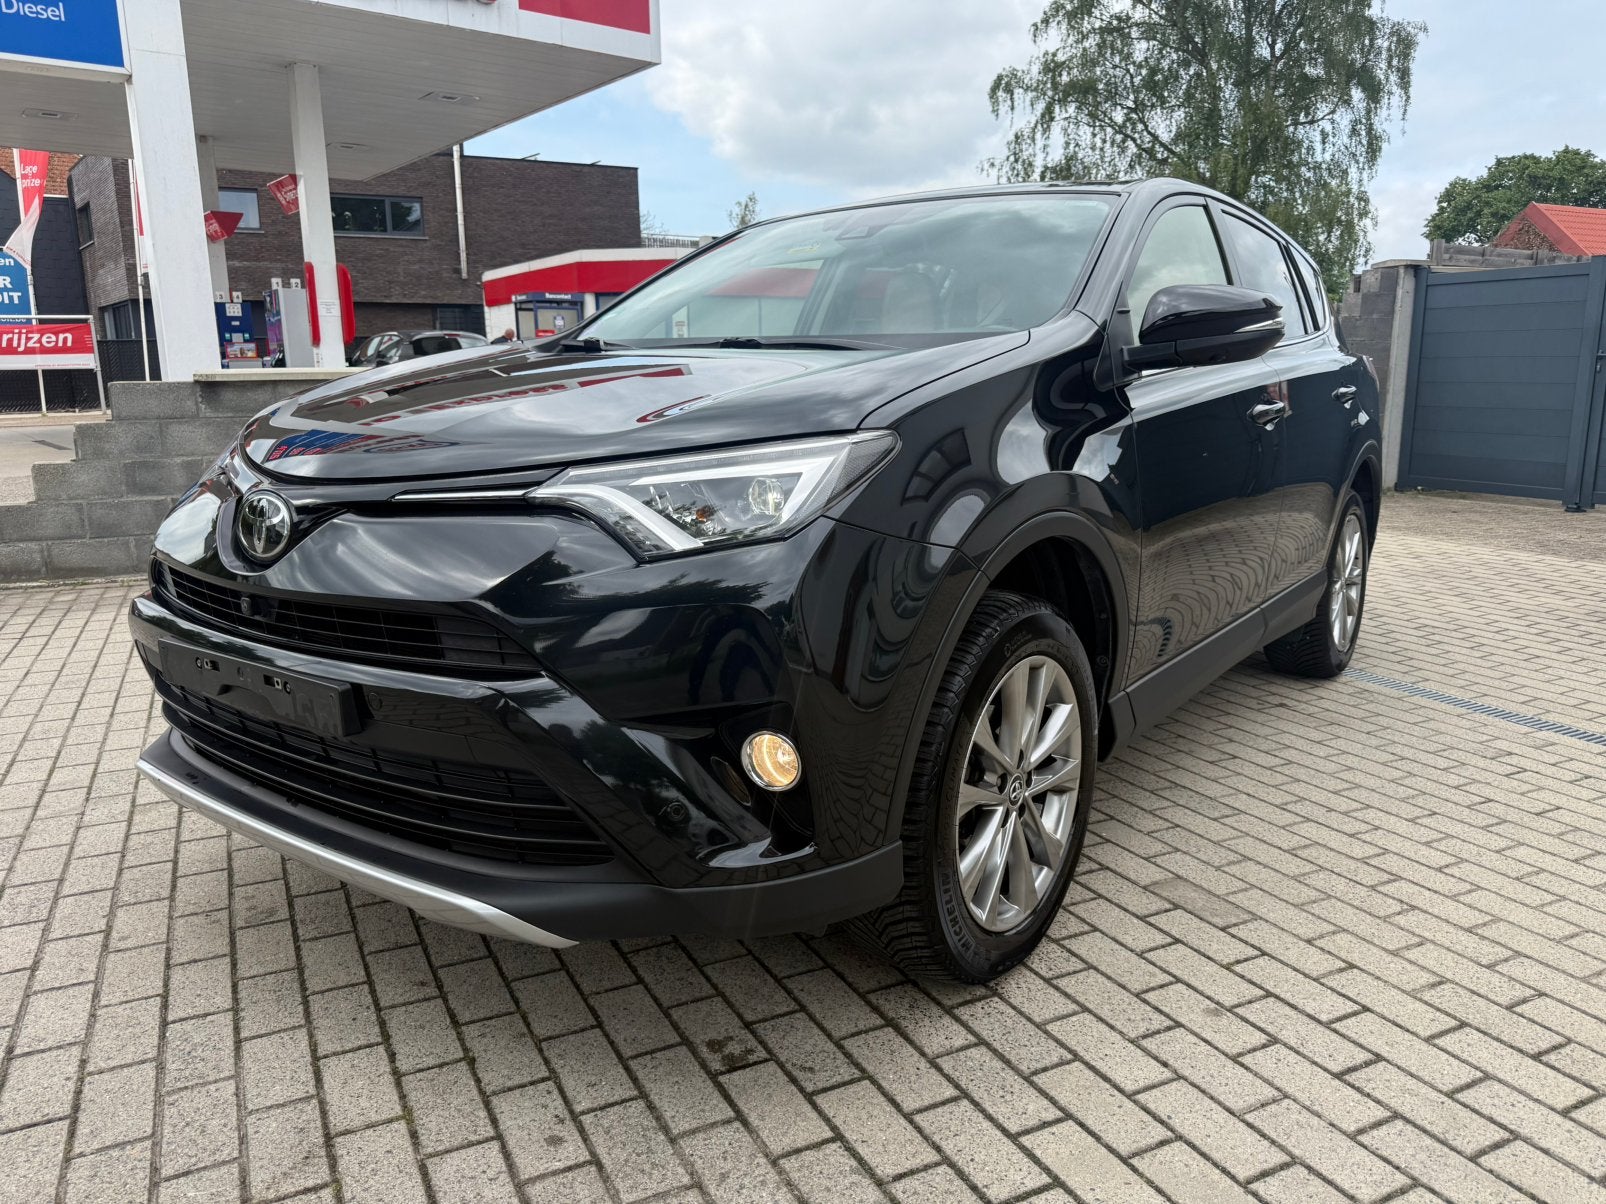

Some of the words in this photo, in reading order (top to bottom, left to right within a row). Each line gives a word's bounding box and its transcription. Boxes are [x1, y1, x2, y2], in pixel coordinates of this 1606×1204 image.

[1, 0, 66, 22] Diesel
[20, 163, 38, 176] Lage
[1, 328, 73, 352] rijzen
[940, 872, 974, 953] MICHELIN
